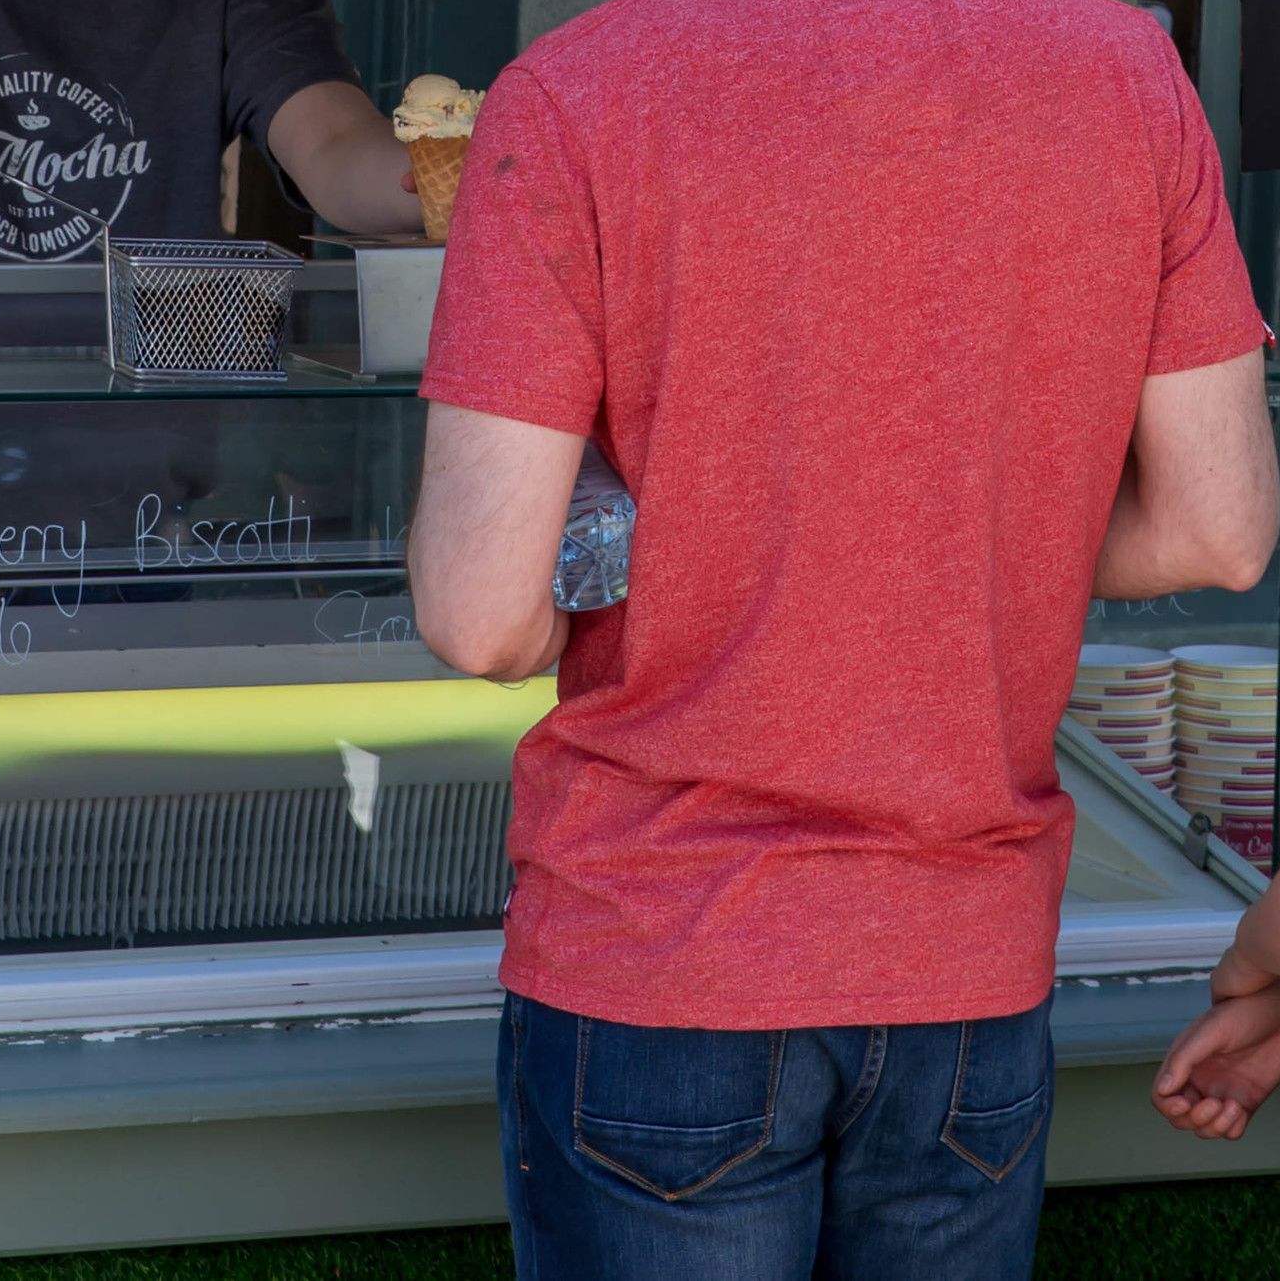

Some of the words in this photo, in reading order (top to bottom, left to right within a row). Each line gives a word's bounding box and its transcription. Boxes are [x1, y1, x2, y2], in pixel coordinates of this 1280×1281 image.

[57, 77, 113, 124] COFFEE
[21, 216, 91, 253] LOMOND
[135, 493, 318, 573] Biscotti
